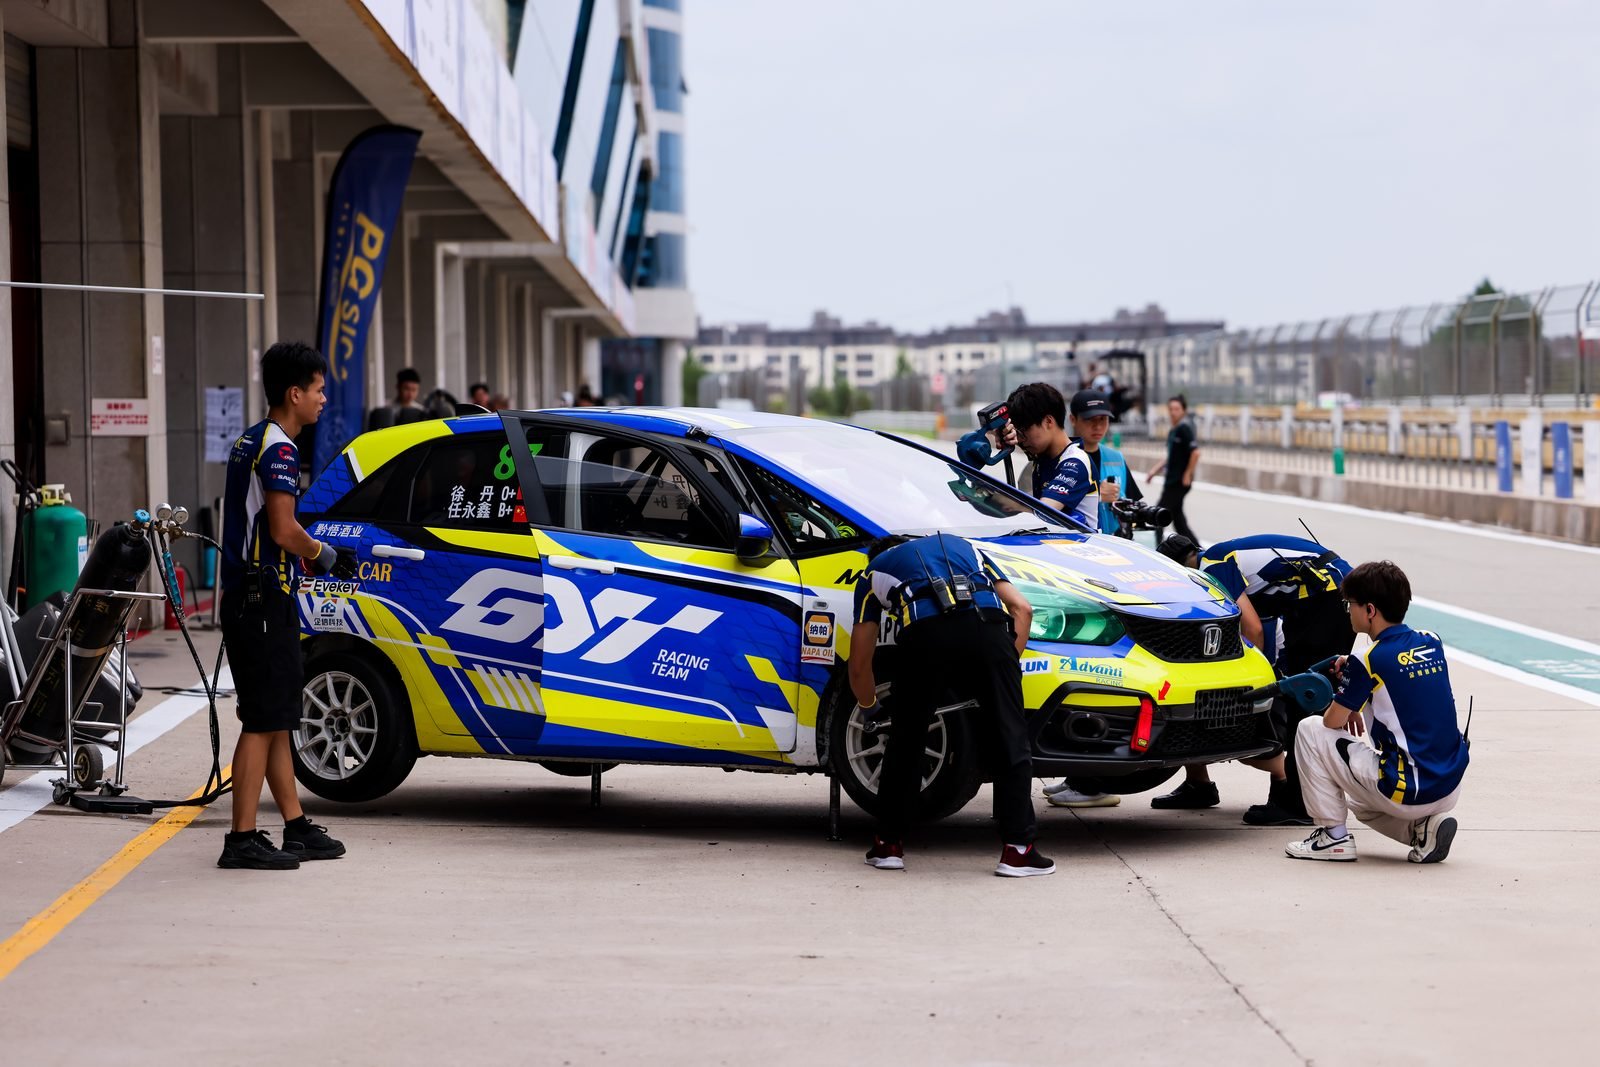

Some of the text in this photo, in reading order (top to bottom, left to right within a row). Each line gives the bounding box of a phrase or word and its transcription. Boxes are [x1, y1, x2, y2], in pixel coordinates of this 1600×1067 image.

[451, 485, 466, 502] 徐
[480, 485, 495, 502] 丹
[448, 501, 513, 519] 任永鑫 B+
[314, 523, 364, 538] 黔悟酒业
[353, 560, 393, 582] CAR
[313, 579, 359, 595] Evekey
[809, 624, 828, 636] 纳帕
[657, 649, 711, 671] RACING
[801, 646, 834, 658] NAPA OIL
[651, 661, 691, 682] TEAM
[1020, 660, 1049, 673] LUN
[1059, 656, 1124, 678] Advanti
[1095, 677, 1124, 688] RACING
